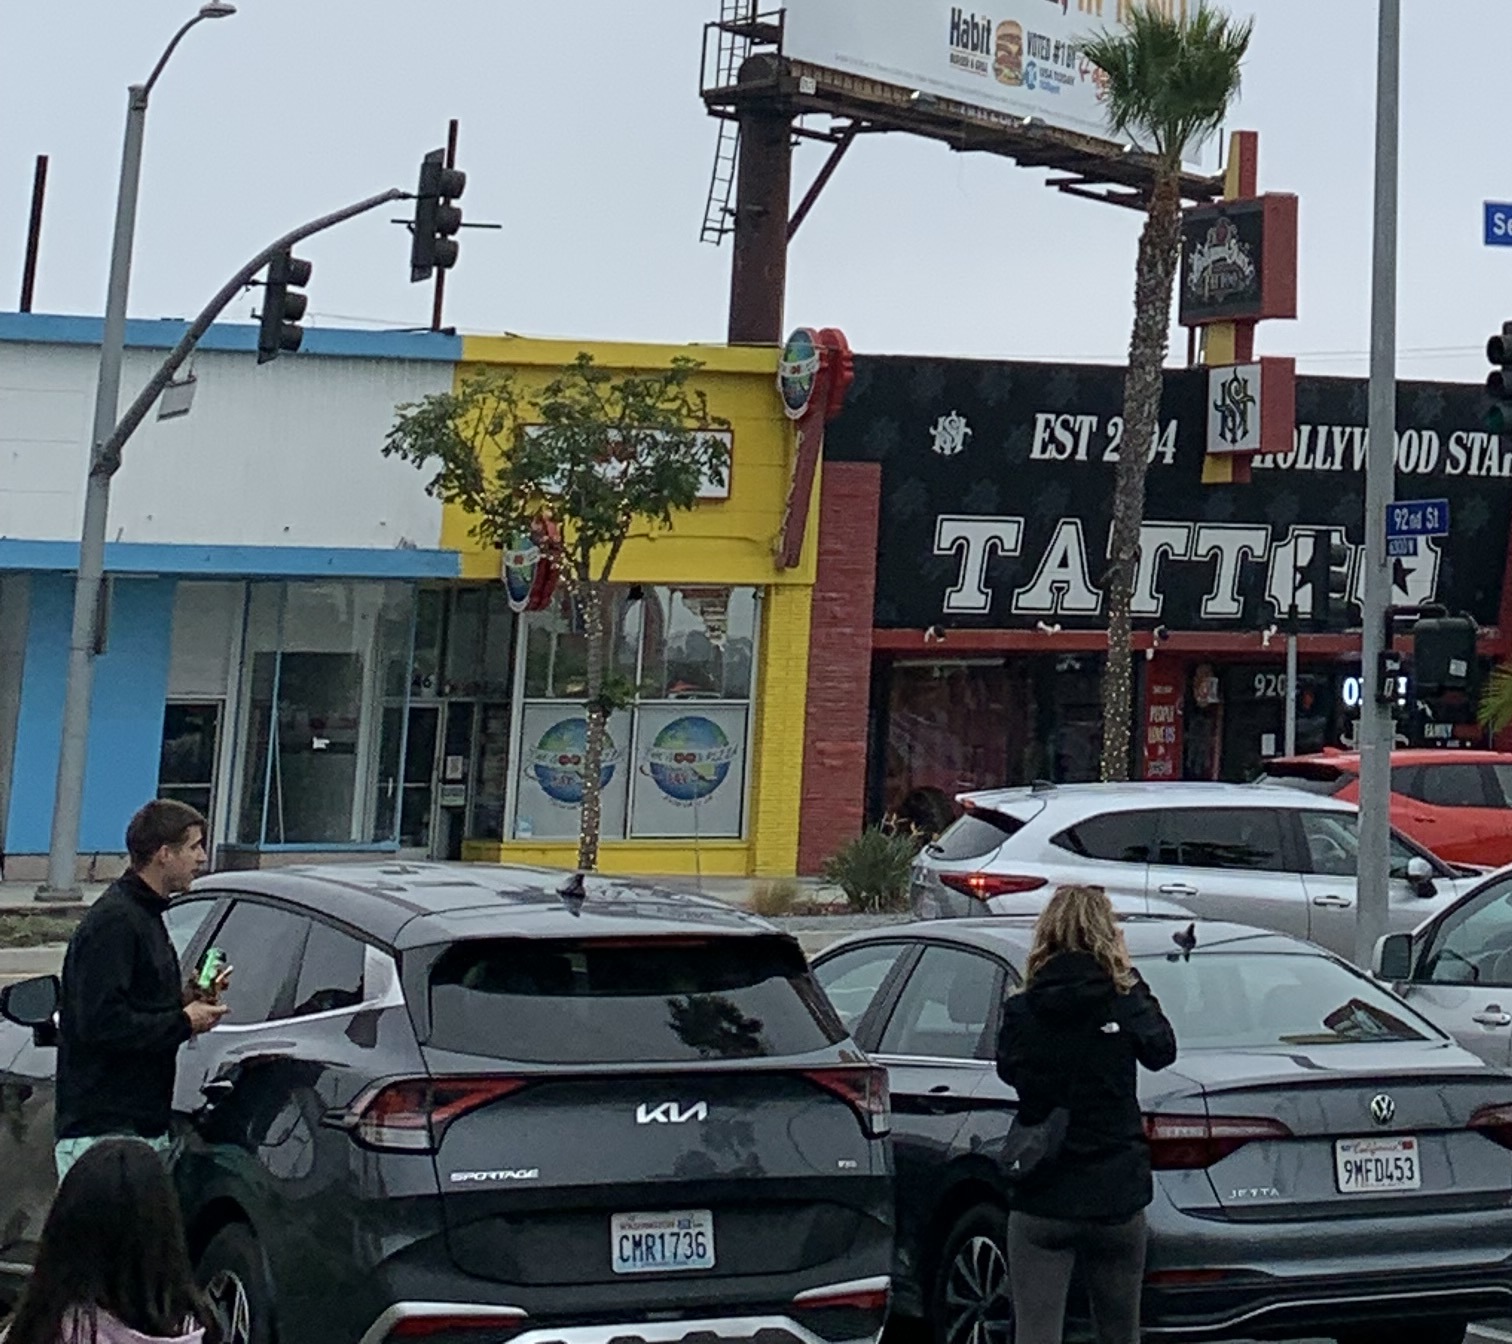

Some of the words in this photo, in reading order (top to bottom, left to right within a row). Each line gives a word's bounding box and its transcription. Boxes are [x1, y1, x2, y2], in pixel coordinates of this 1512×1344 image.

[949, 6, 992, 56] Habit
[1029, 412, 1098, 462] EST
[1250, 424, 1440, 474] OLLYWOD
[1393, 506, 1423, 531] 92nd
[636, 1100, 708, 1124] KIA
[450, 1168, 539, 1183] SPORTAGE
[1343, 1156, 1415, 1185] 9MFD453
[618, 1231, 708, 1264] CMR1736
